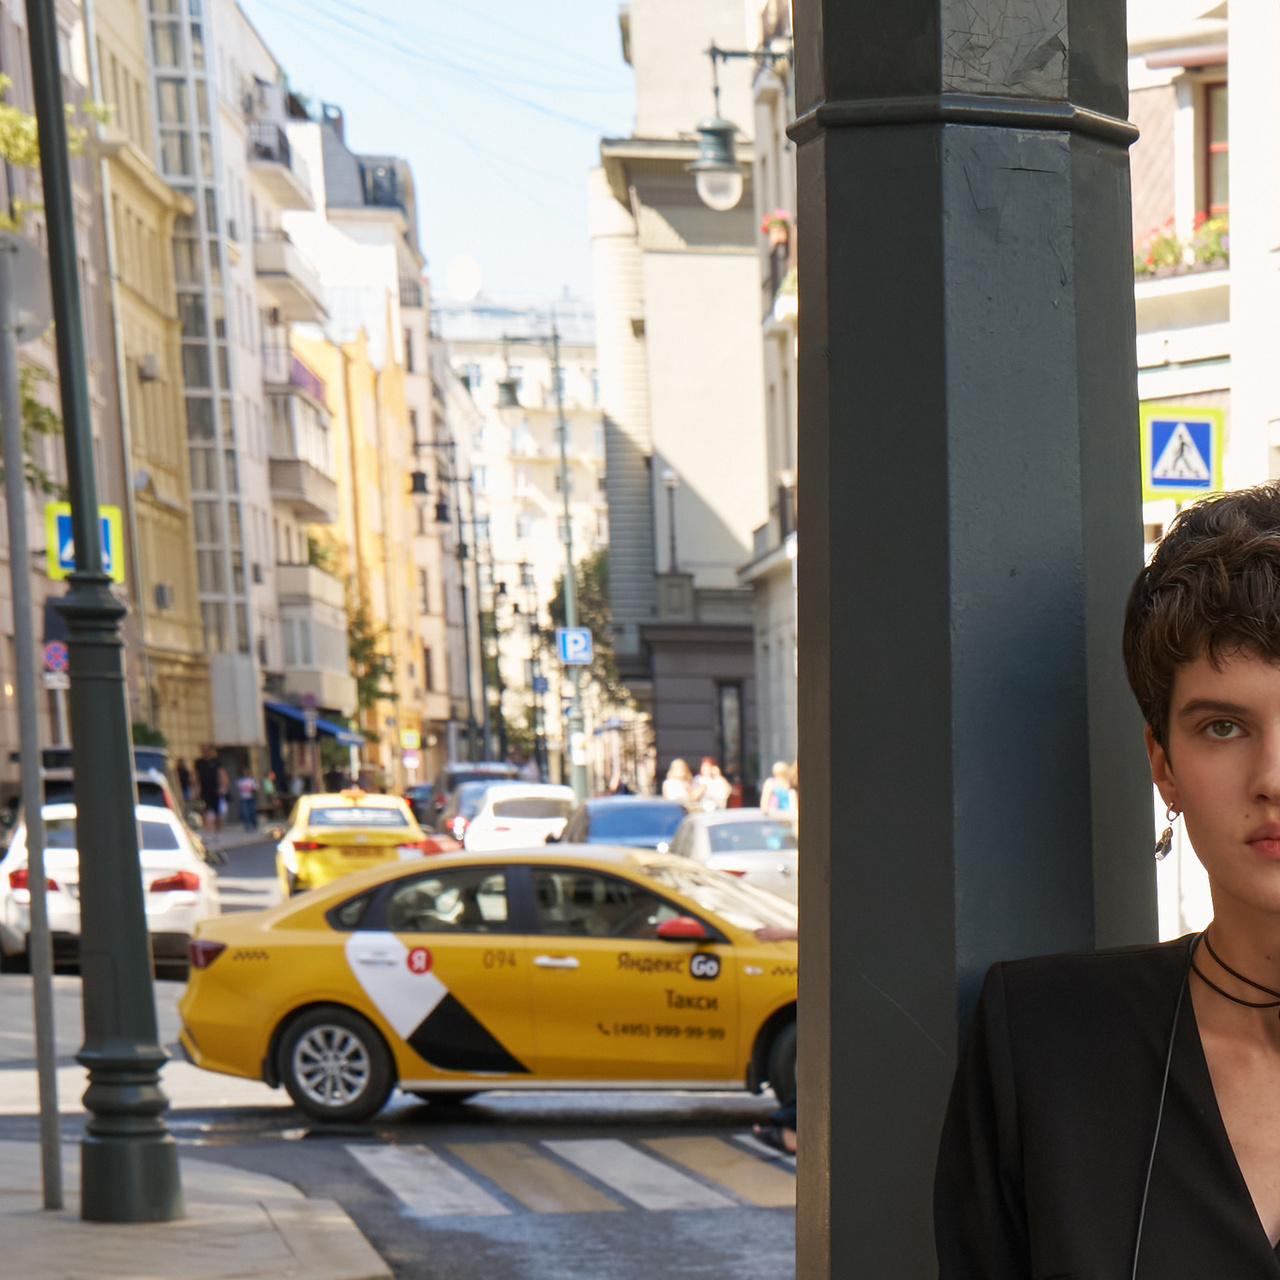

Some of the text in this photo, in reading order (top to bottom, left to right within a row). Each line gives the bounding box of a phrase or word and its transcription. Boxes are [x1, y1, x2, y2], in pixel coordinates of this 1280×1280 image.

[411, 950, 428, 971] Я
[617, 952, 720, 978] Яндекс Go
[666, 989, 719, 1011] Такси
